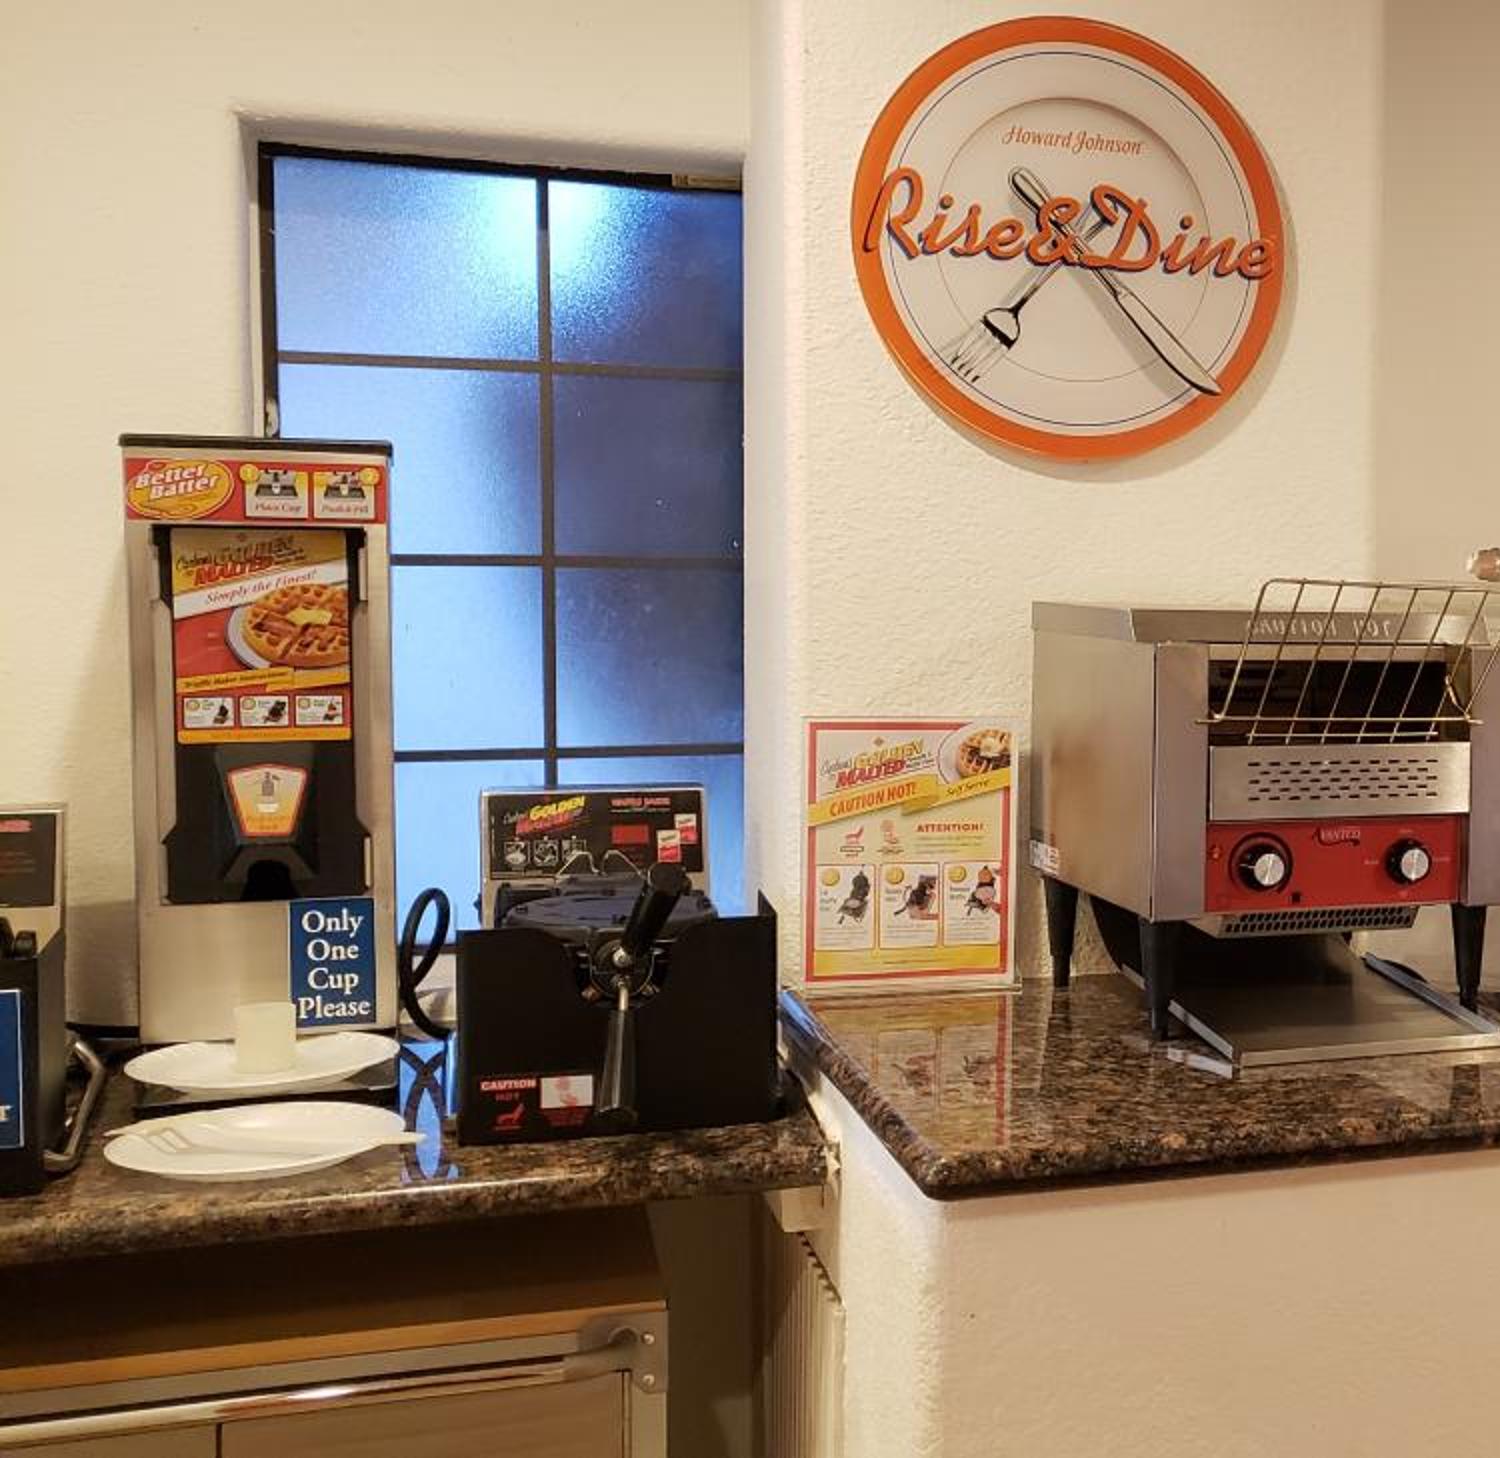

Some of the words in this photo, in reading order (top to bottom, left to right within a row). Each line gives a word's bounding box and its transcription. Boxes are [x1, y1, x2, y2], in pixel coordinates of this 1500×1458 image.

[1002, 125, 1073, 147] Howard
[1072, 131, 1143, 155] Johnson
[136, 463, 205, 488] Better
[150, 474, 218, 500] Batter
[205, 585, 249, 604] Simply
[251, 579, 271, 593] the
[836, 757, 907, 789] MALTED
[529, 795, 585, 820] GOLDEN
[829, 791, 887, 818] CAUTION
[887, 781, 918, 803] HOT!
[916, 822, 985, 833] ATTENTION!
[301, 907, 364, 938] Only
[306, 939, 360, 962] One
[307, 967, 360, 995] Cup
[298, 996, 371, 1020] Please
[480, 1079, 537, 1091] CAUTION
